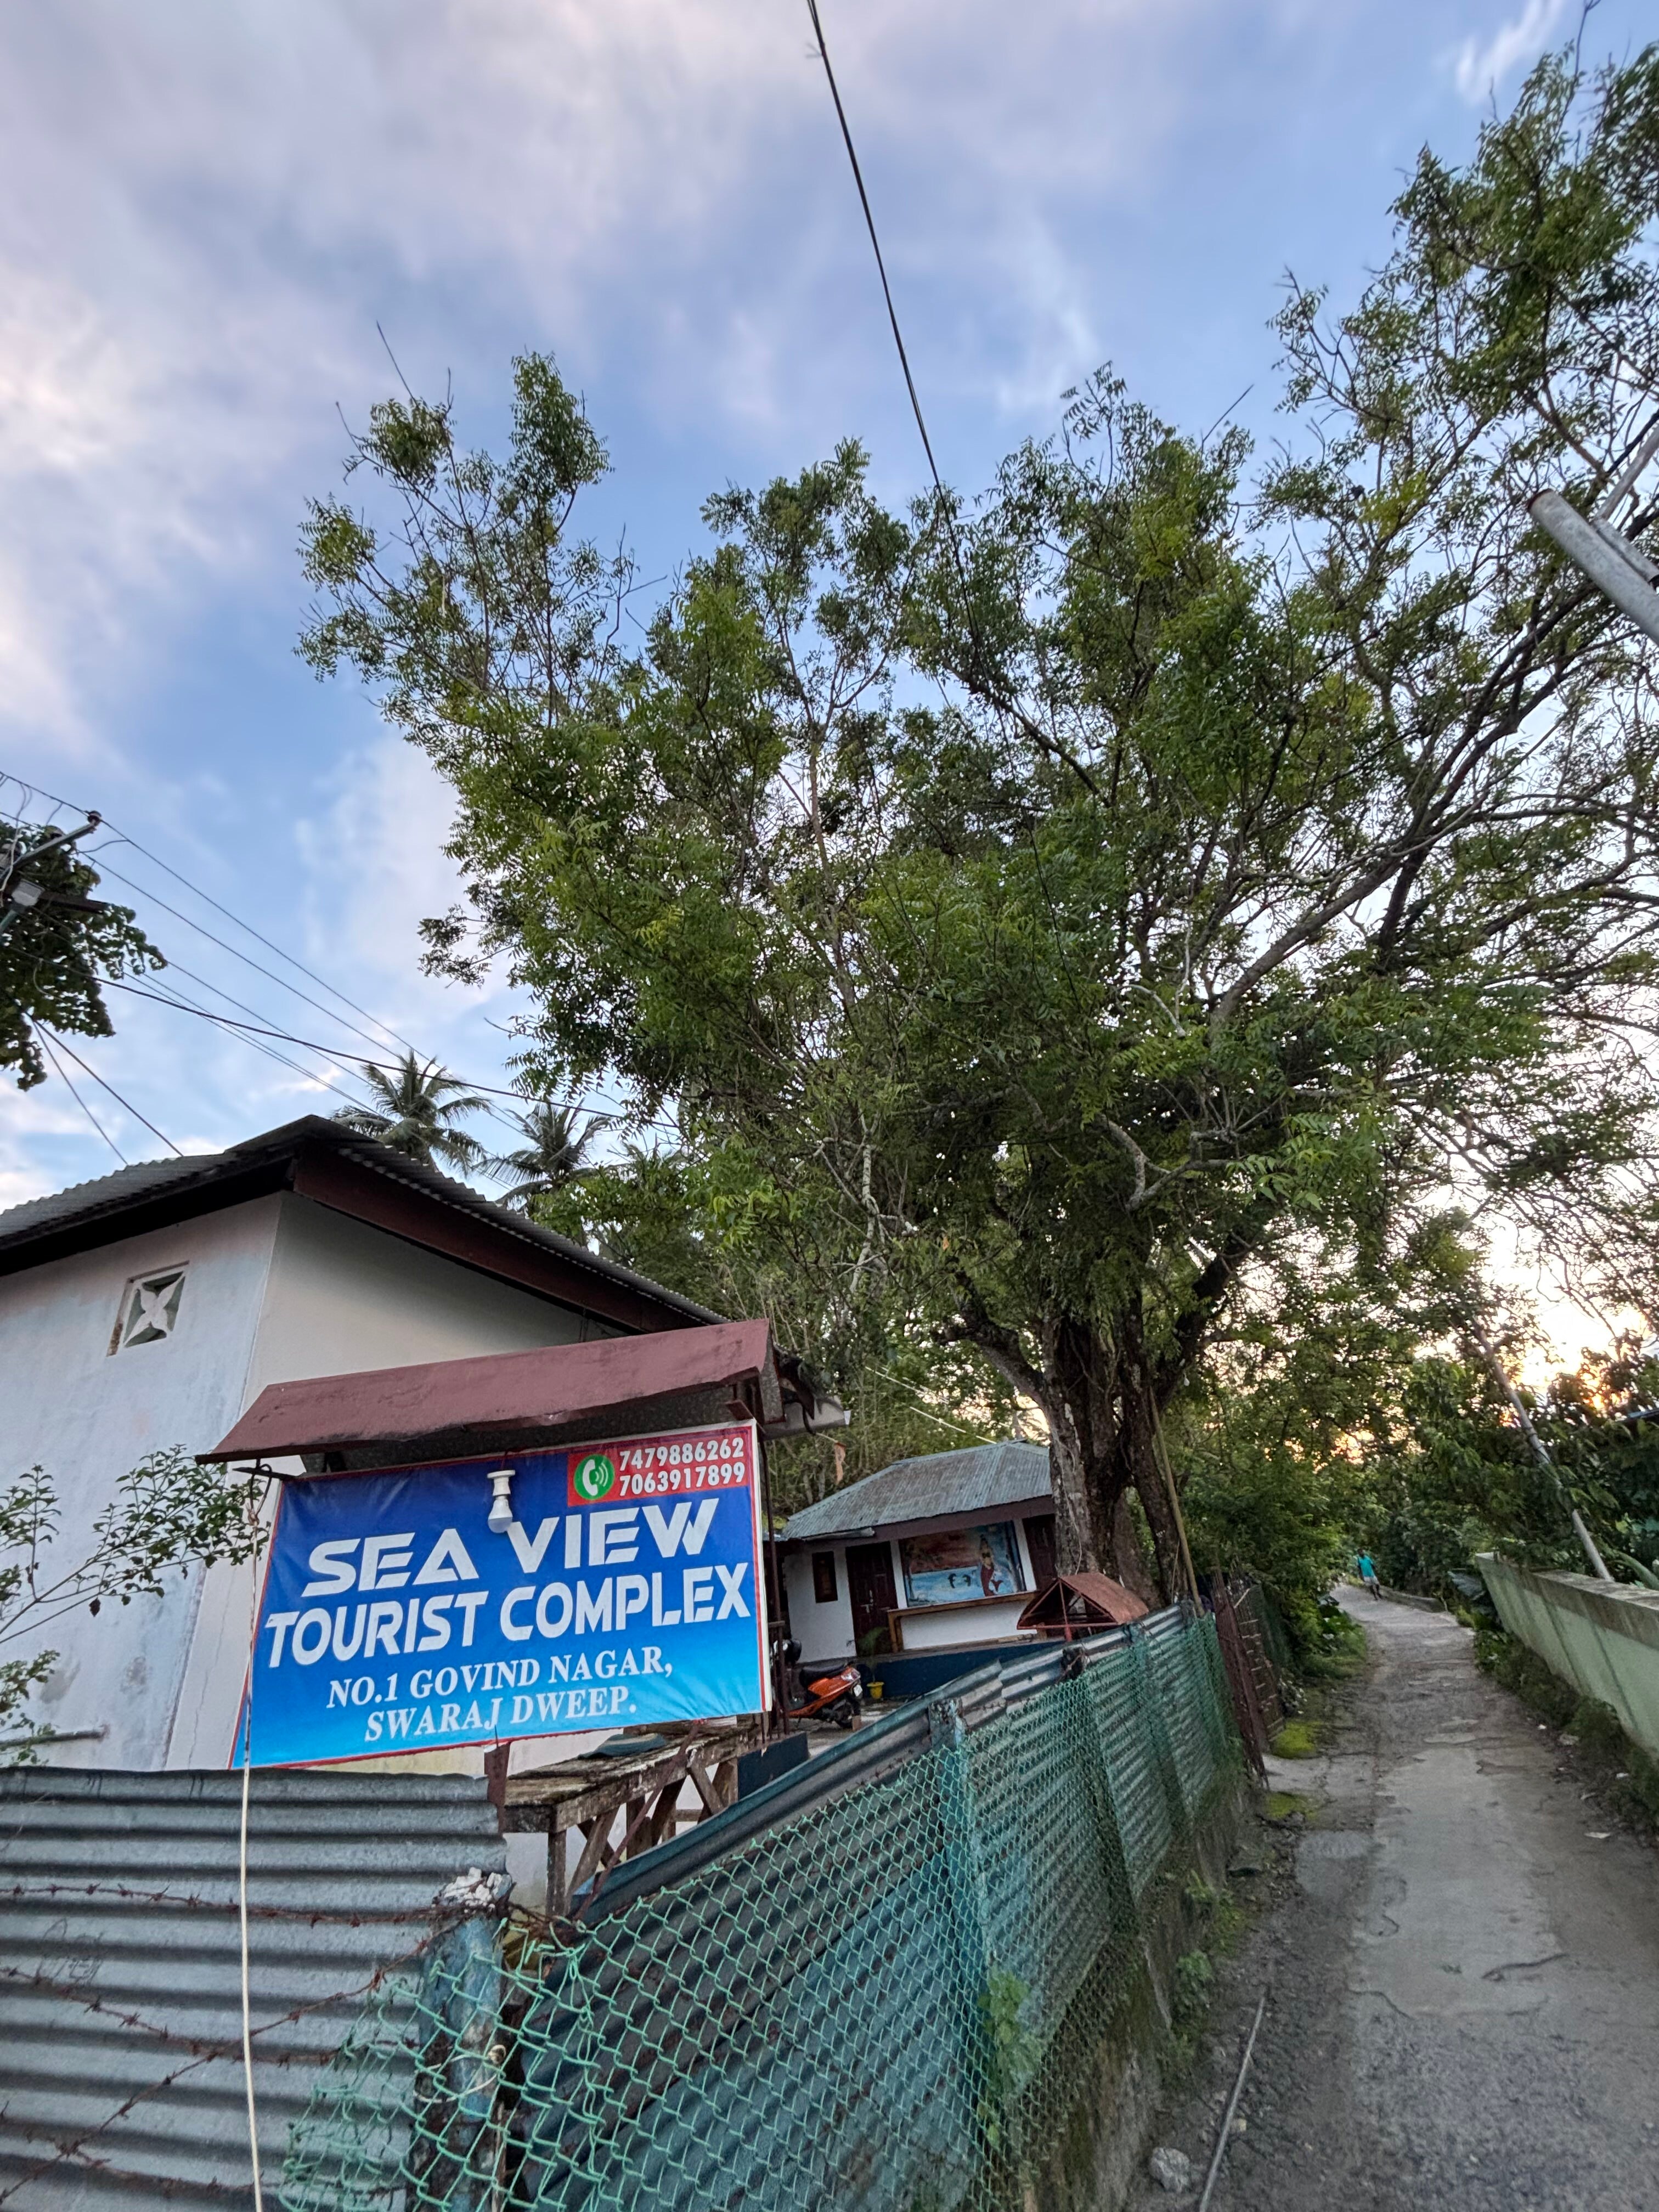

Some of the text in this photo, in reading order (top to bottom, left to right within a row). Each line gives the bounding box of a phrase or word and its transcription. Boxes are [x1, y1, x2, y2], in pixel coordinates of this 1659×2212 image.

[620, 1437, 744, 1471] 7479886262
[620, 1462, 744, 1496] 7063917899
[301, 1498, 719, 1597] SEA VIEW
[266, 1562, 750, 1668] TOURIST COMPLEX
[327, 1646, 673, 1708] NO.1 GOVIND NAGAR,
[365, 1686, 636, 1742] SWARAJ DWEEP.
